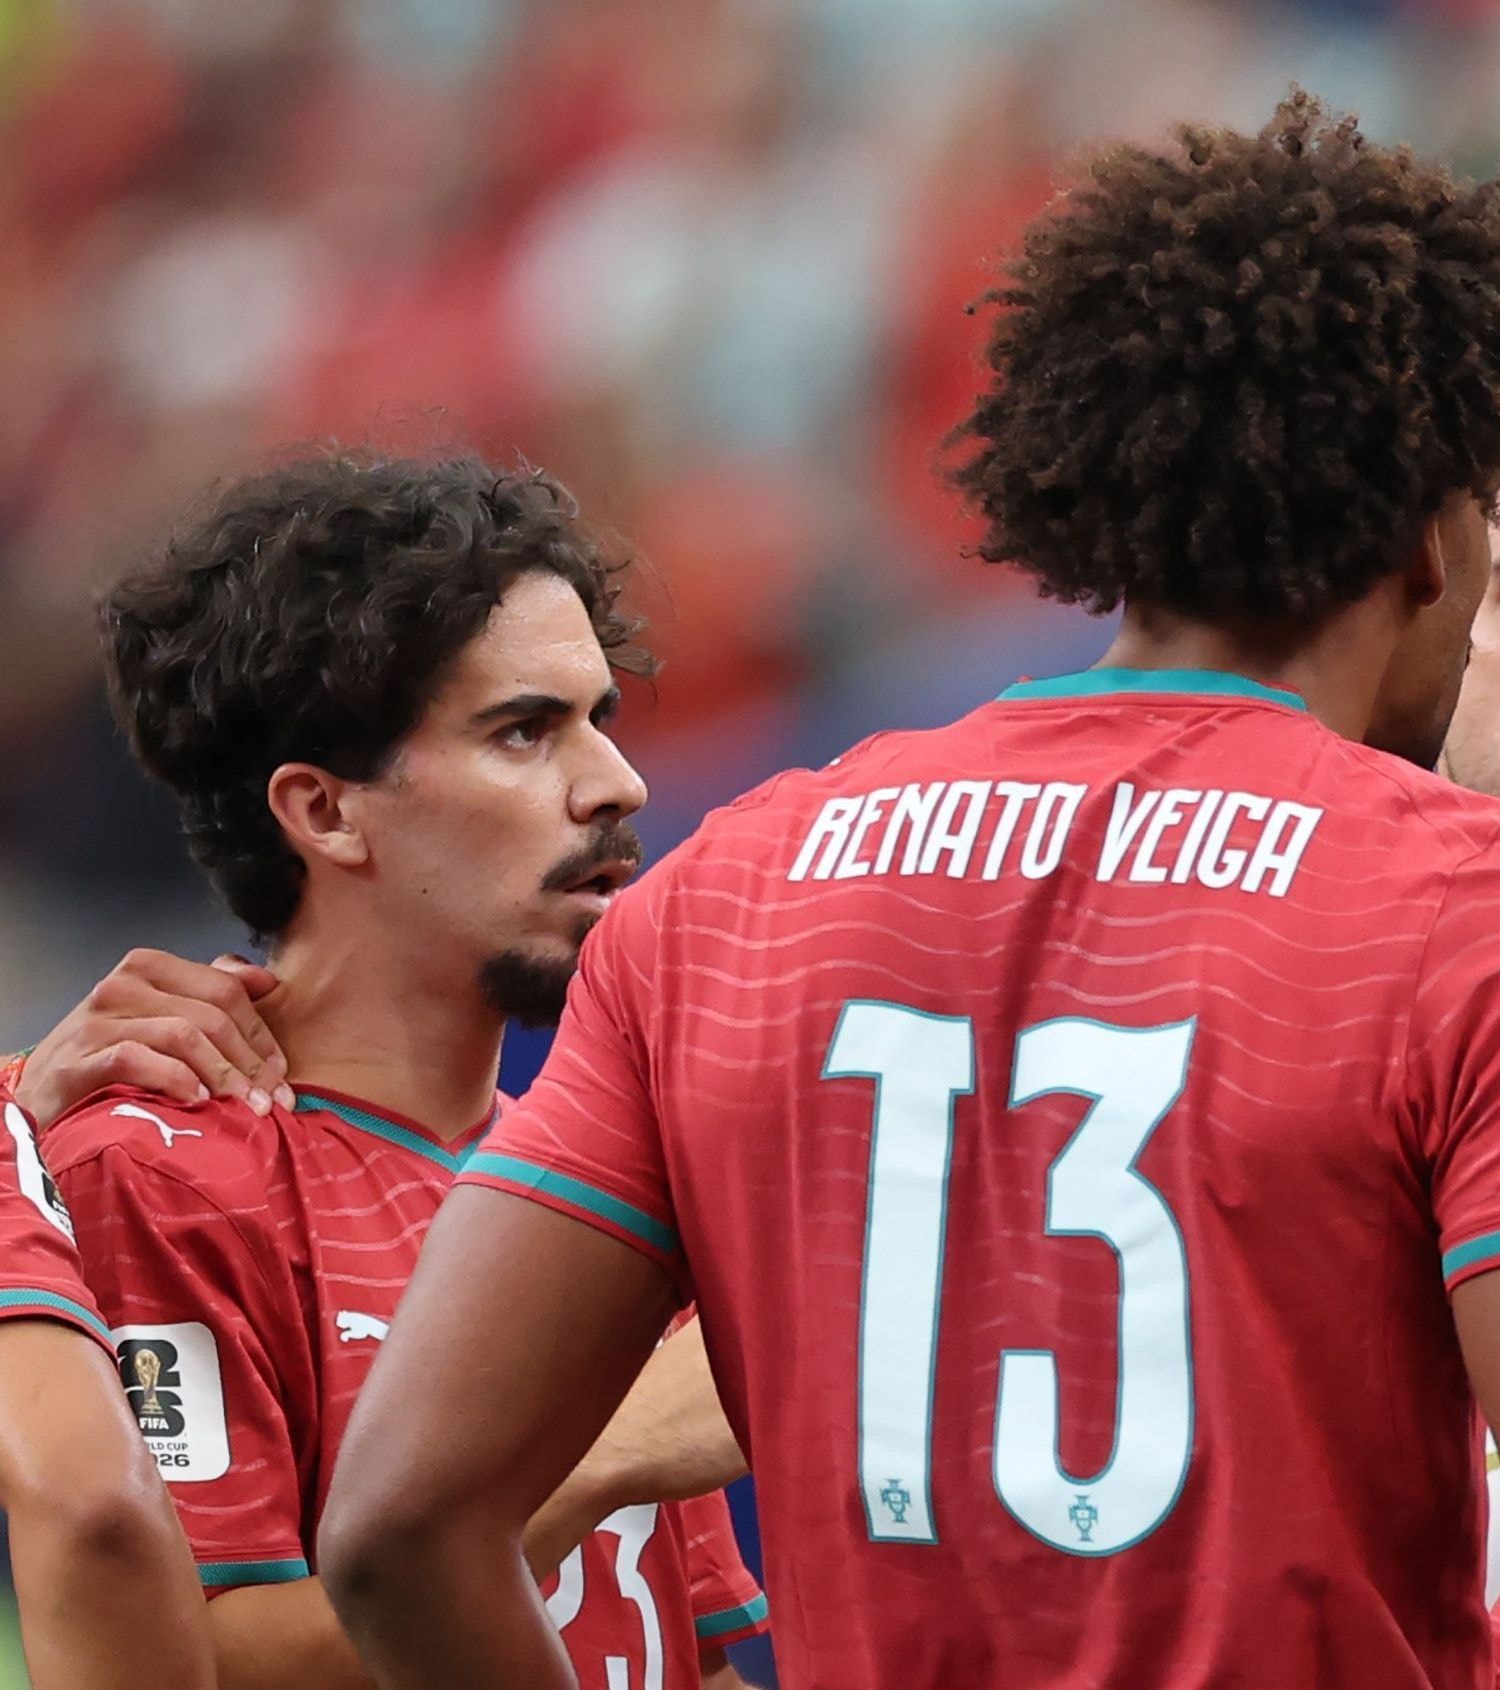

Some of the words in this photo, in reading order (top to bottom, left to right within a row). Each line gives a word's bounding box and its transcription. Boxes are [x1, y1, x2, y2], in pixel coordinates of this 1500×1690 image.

[787, 780, 1087, 882] RENATO
[1096, 782, 1323, 898] VEIGA
[820, 999, 1197, 1557] 13
[139, 1417, 170, 1430] FIFA
[167, 1442, 188, 1451] CUP
[154, 1453, 190, 1467] 26
